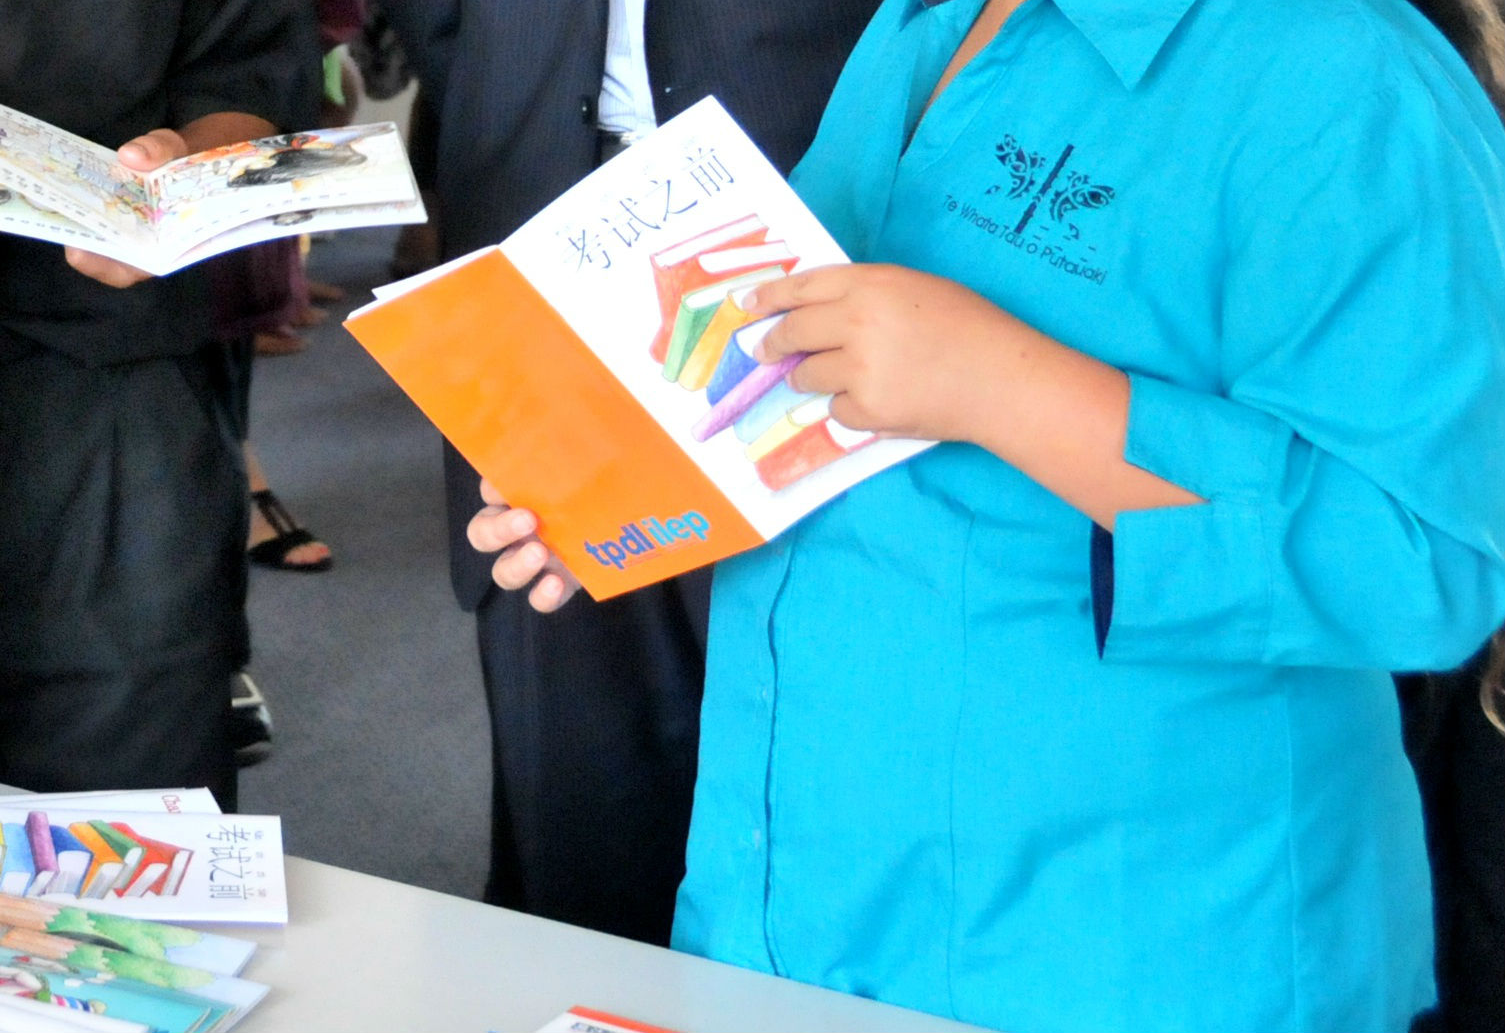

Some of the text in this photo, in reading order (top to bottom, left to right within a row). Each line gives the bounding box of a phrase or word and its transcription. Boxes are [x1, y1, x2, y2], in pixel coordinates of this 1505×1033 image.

[562, 147, 735, 273] 考试之前
[943, 194, 959, 212] Te
[960, 201, 998, 236] Whata
[996, 225, 1026, 248] Tau
[584, 510, 710, 570] tpdl ilep
[206, 823, 254, 900] 考试之前
